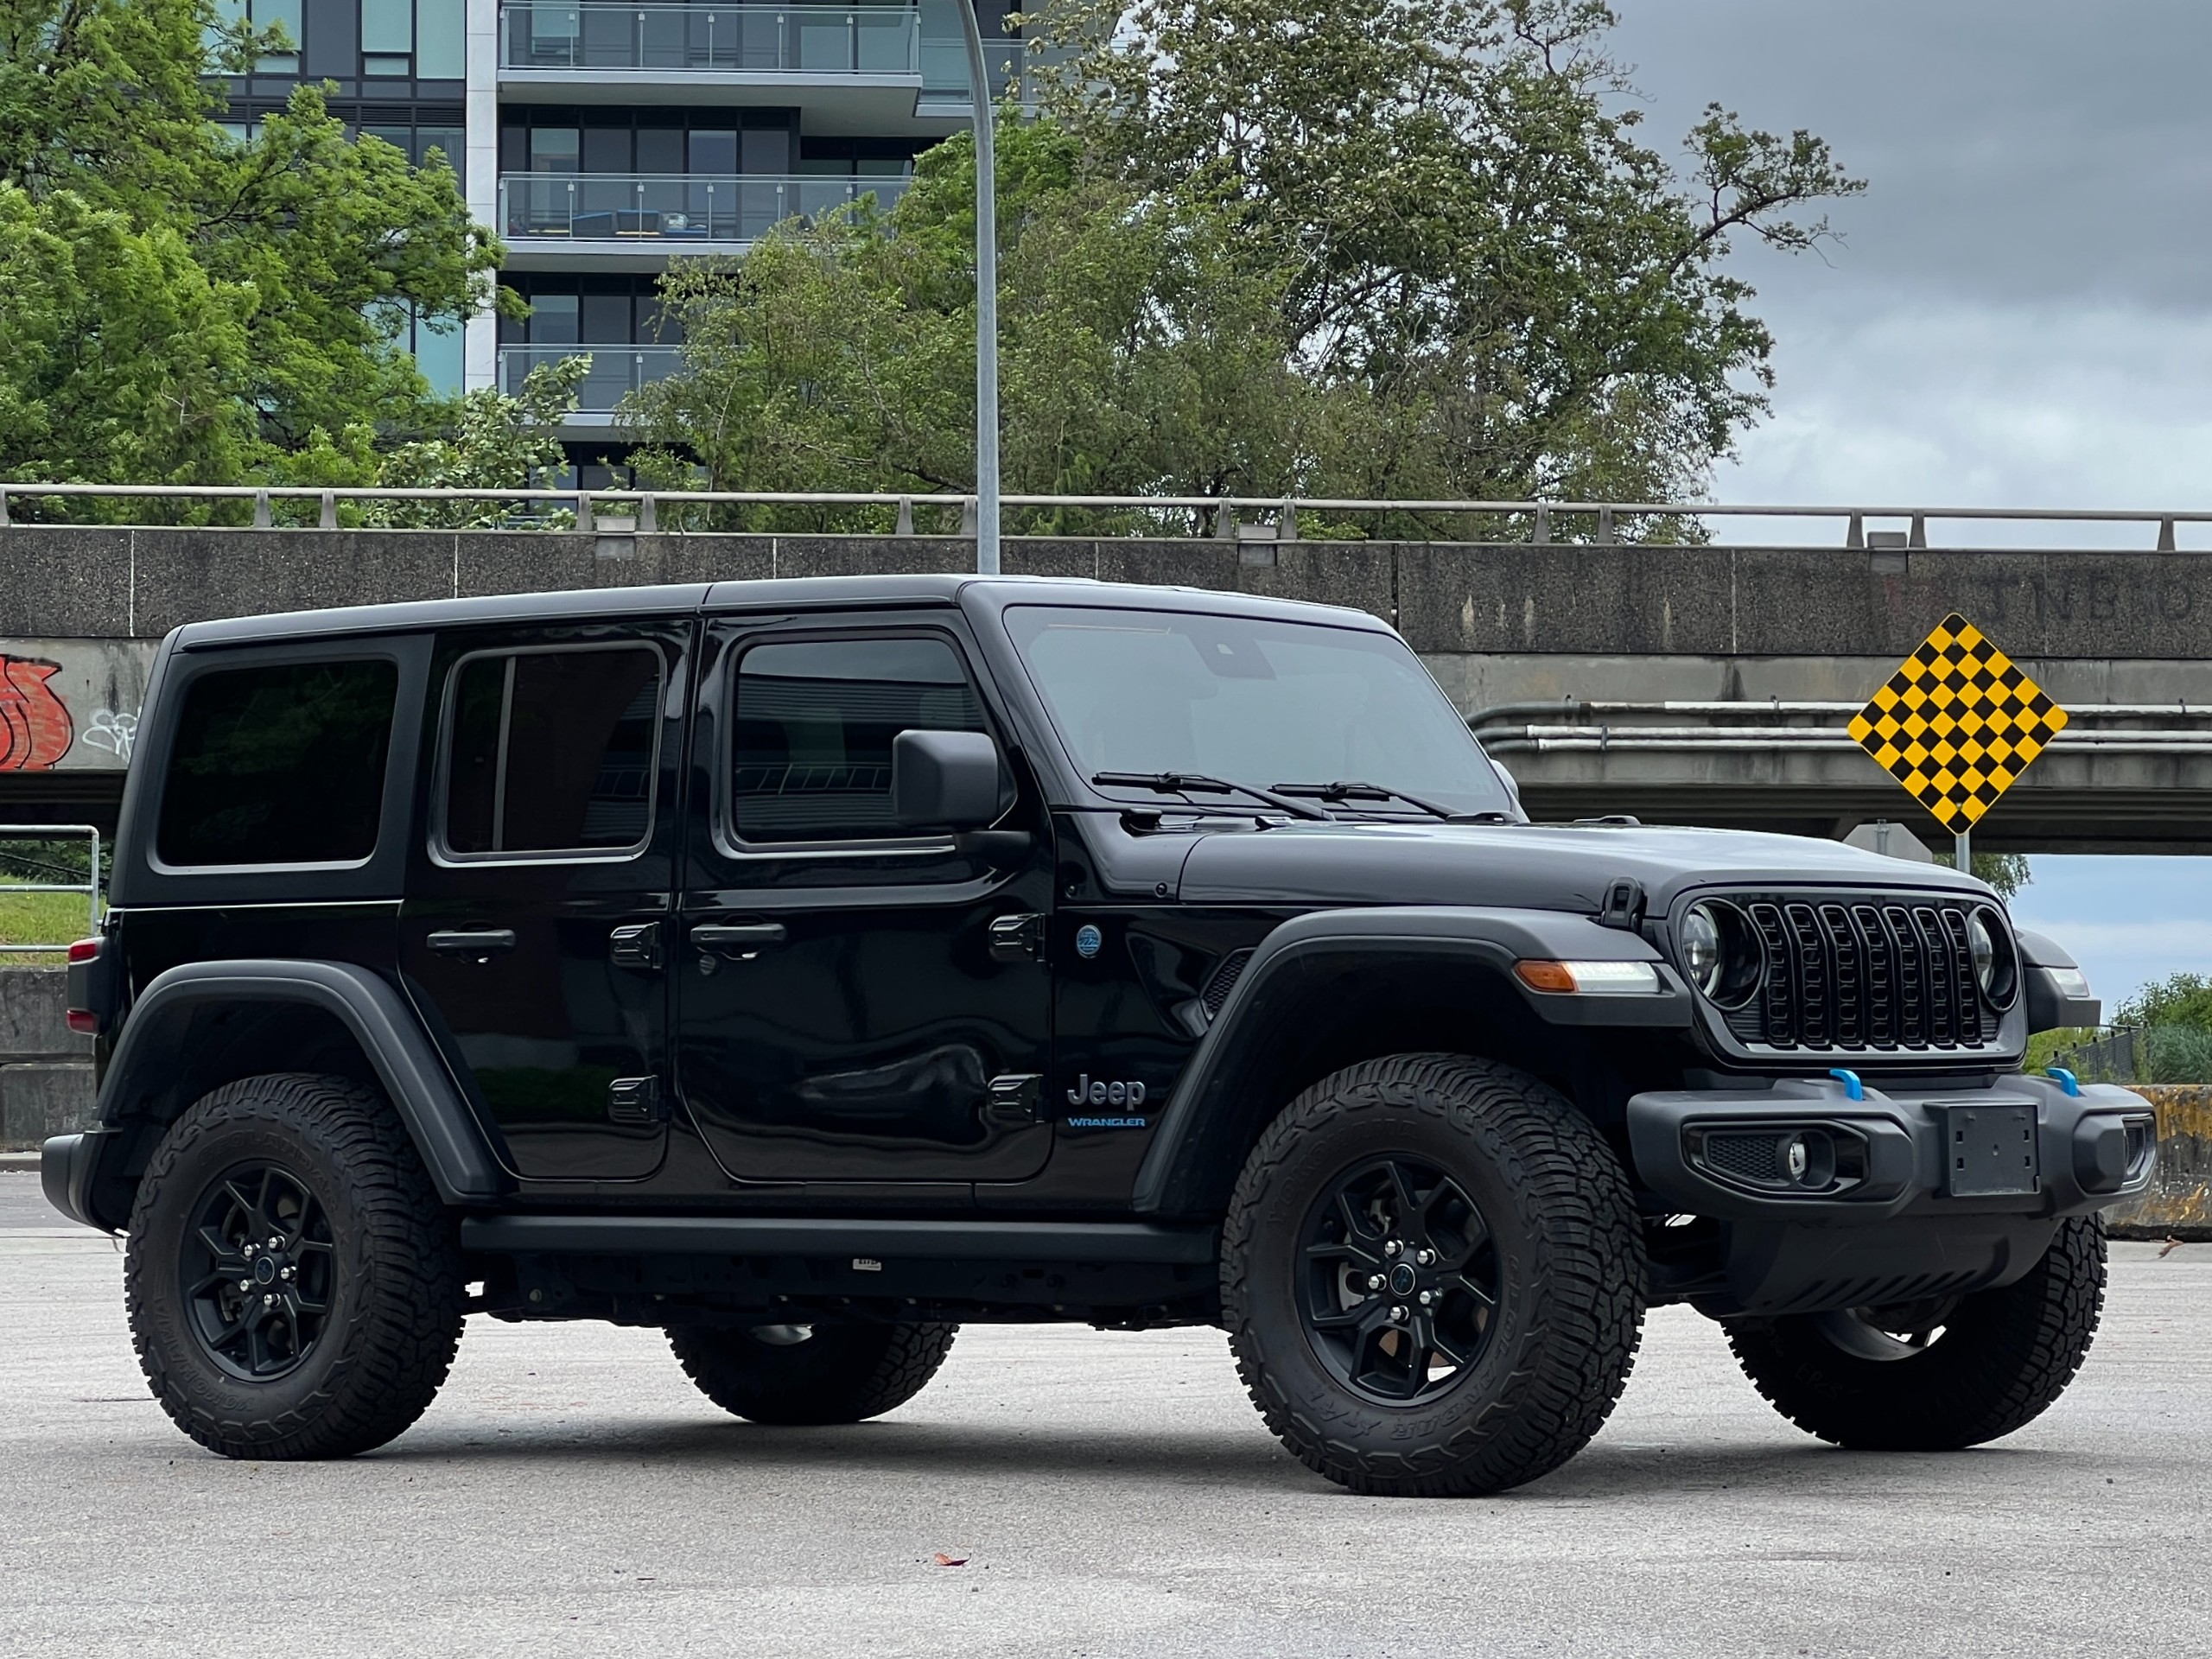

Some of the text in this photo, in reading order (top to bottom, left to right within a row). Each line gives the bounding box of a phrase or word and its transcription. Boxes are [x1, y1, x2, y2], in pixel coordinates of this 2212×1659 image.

[1067, 1074, 1146, 1111] Jeep
[1067, 1117, 1146, 1127] WRANGLER
[1266, 1117, 1418, 1224] YOKOHAMA
